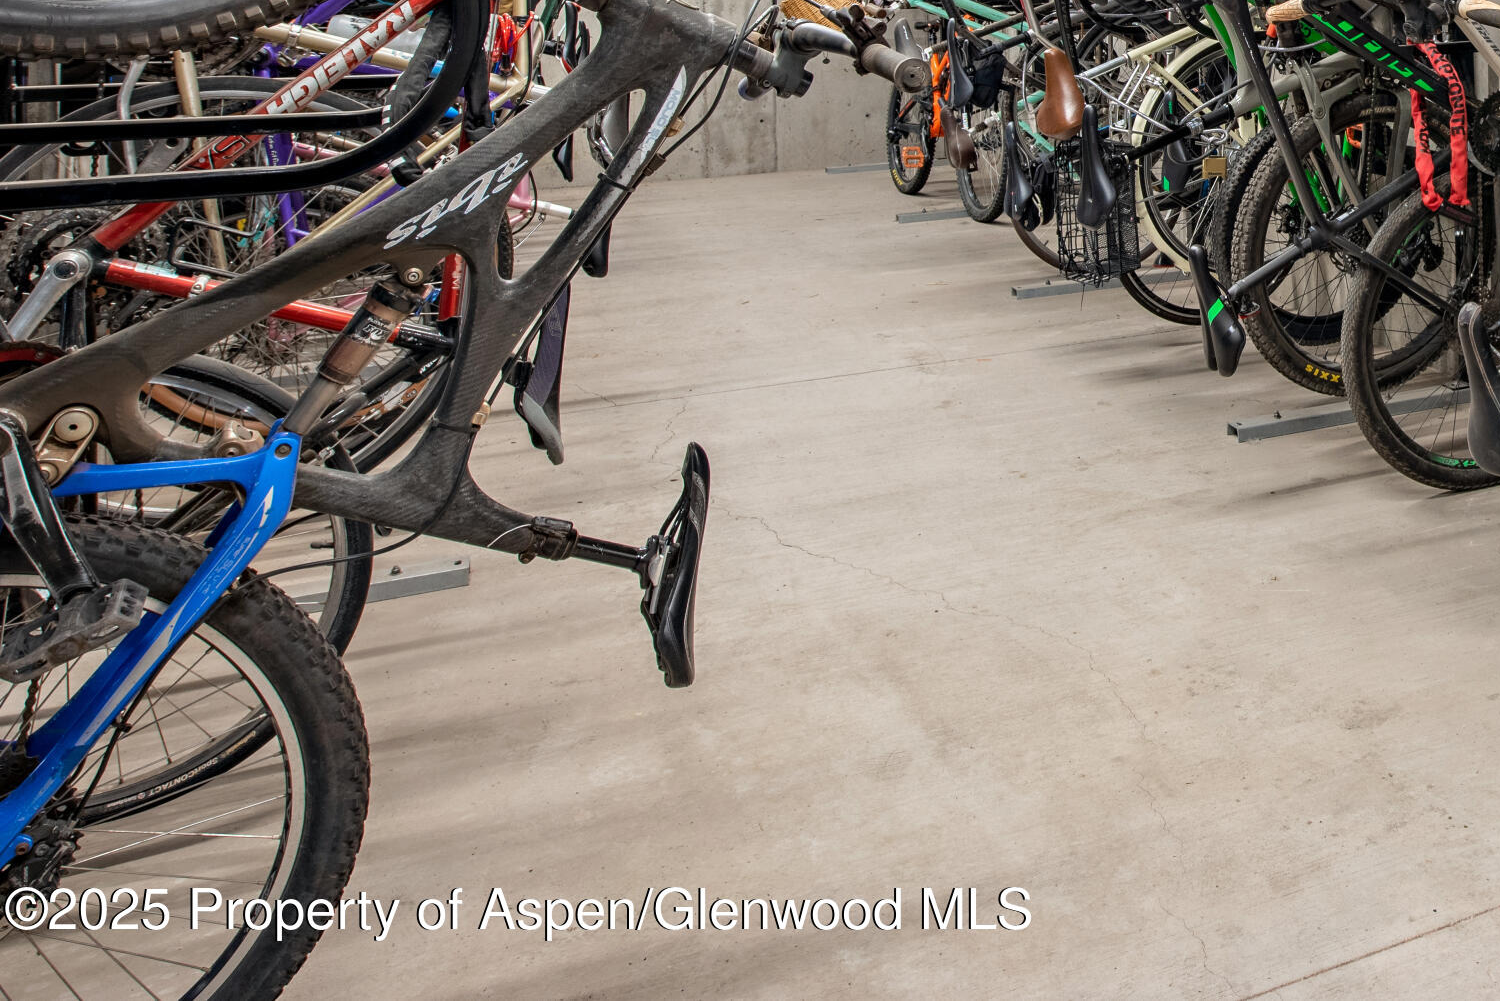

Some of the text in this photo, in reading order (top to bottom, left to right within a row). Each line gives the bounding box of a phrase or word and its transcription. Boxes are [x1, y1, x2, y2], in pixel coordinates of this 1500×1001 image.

[267, 0, 416, 114] RALEIGH
[656, 89, 681, 127] MOJO
[383, 152, 529, 250] ibis
[1305, 364, 1341, 383] XXIS
